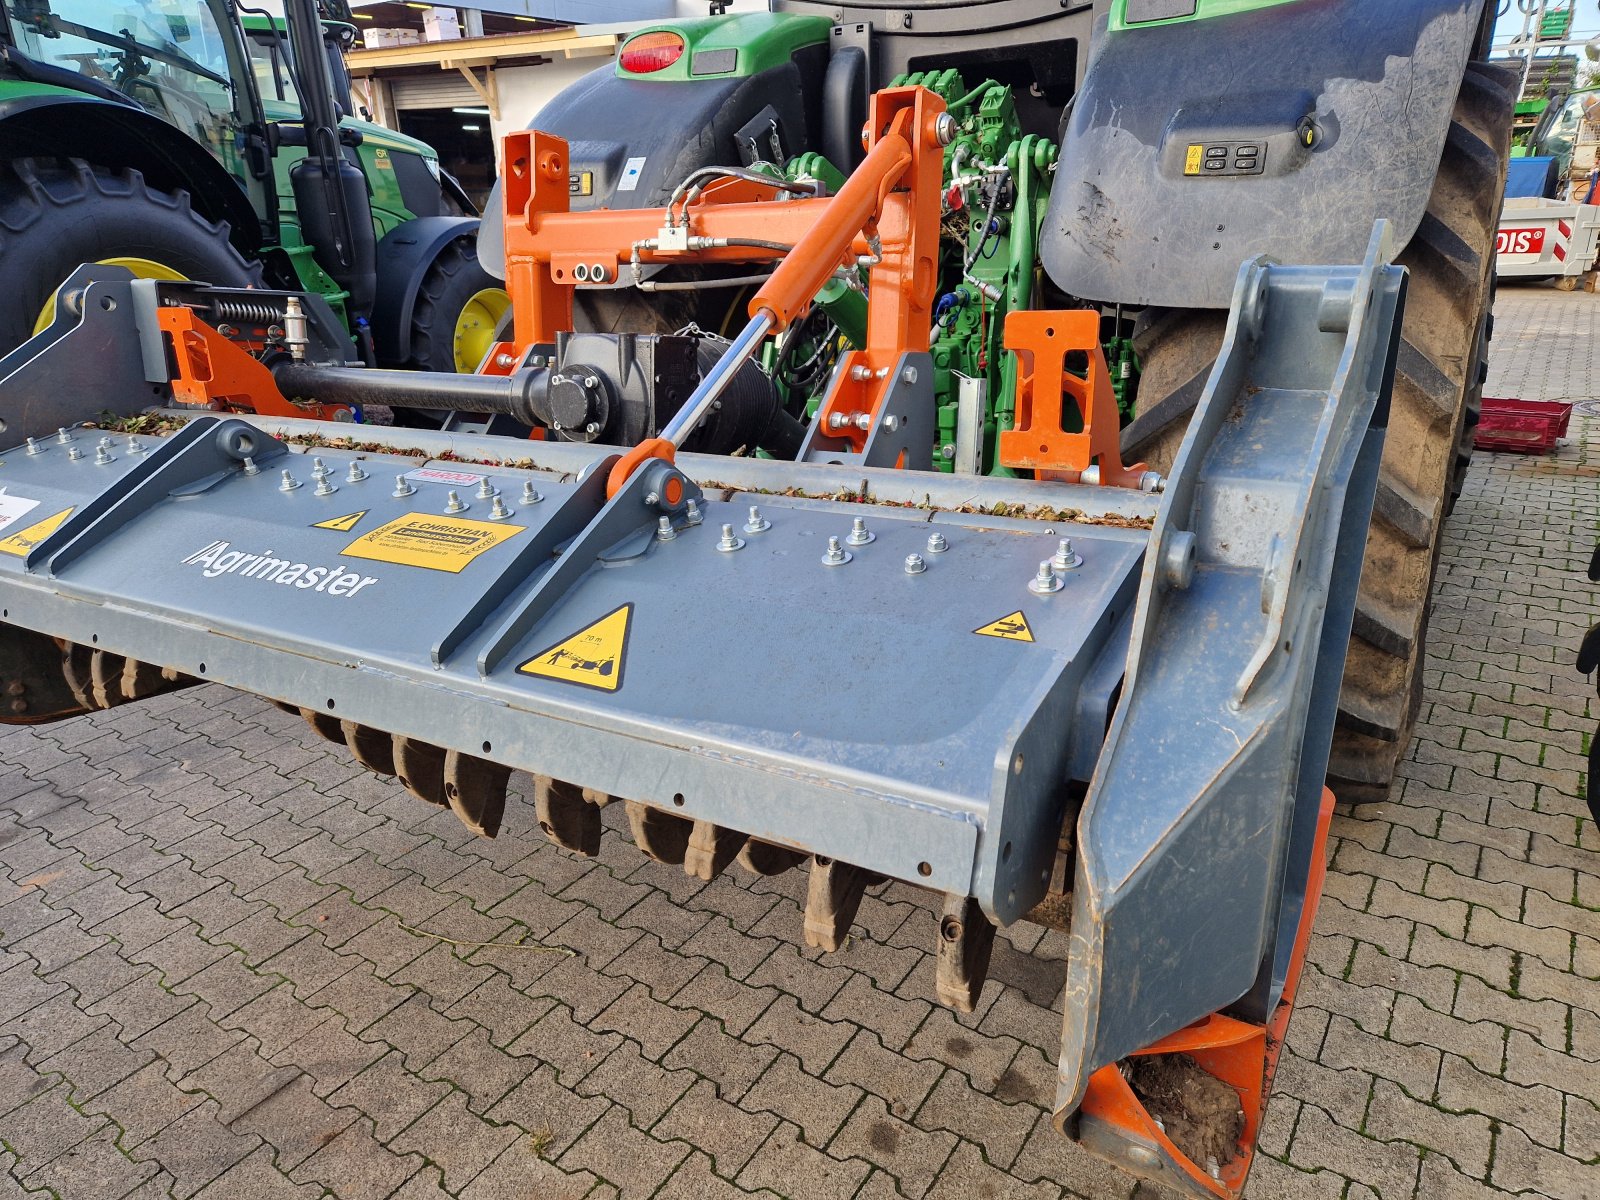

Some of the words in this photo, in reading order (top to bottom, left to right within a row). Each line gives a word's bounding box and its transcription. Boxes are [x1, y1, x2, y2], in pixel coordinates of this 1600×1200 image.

[399, 529, 473, 544] Landmaschinen
[418, 522, 493, 538] CHRISTIAN
[182, 540, 379, 597] Agrimaster
